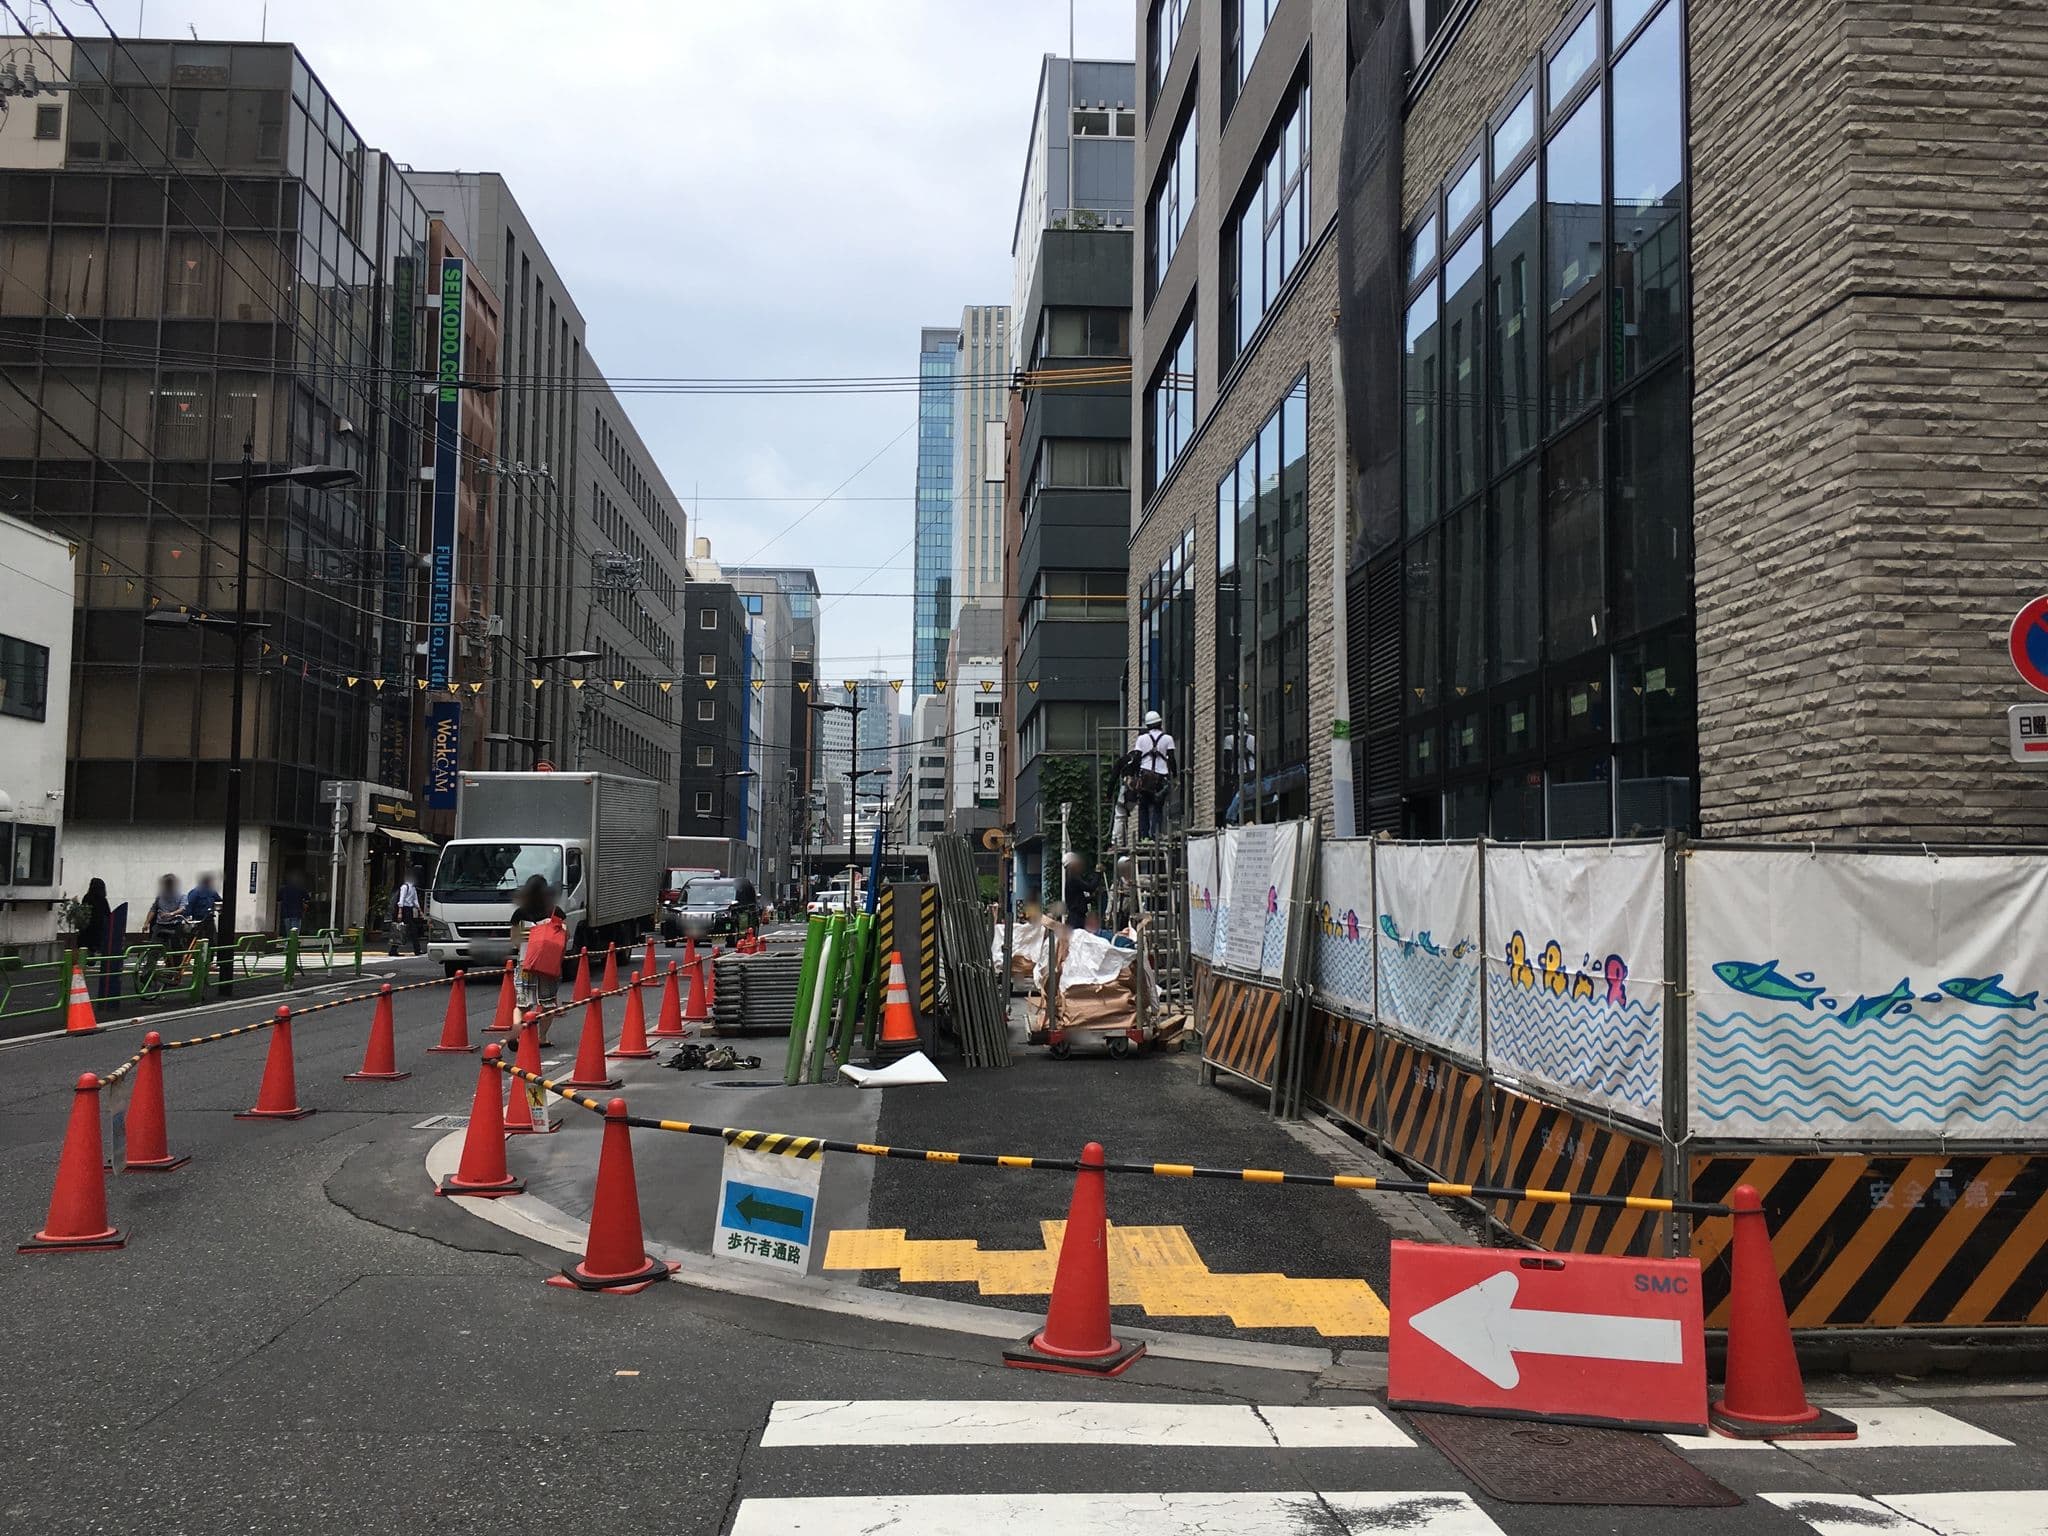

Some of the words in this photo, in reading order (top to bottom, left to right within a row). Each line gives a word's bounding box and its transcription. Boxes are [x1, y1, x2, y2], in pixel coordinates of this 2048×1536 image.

[440, 268, 461, 402] SEIKODO.COM
[727, 1232, 801, 1264] 歩行者通路
[1634, 1273, 1688, 1294] SMC
